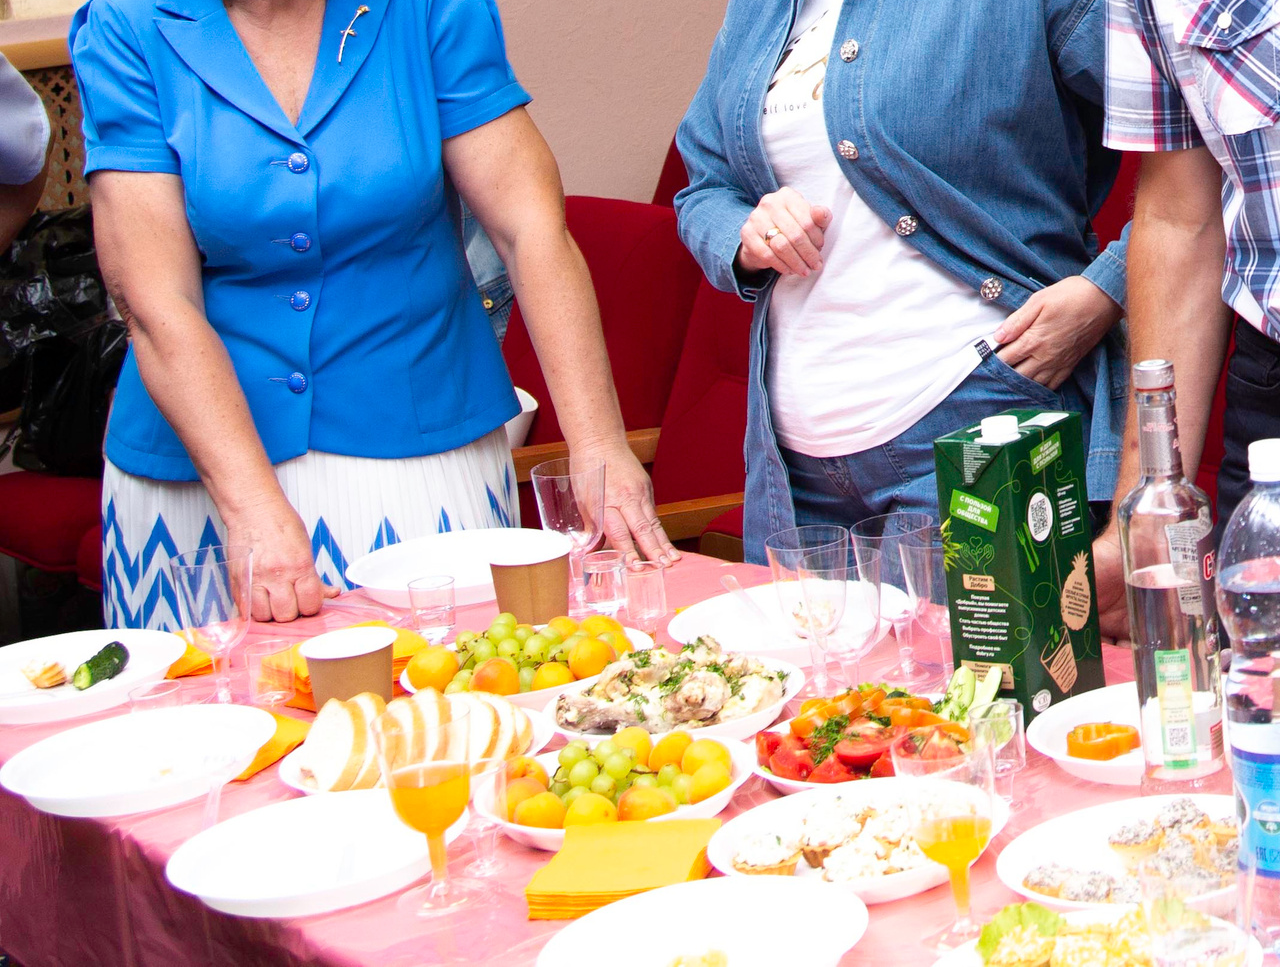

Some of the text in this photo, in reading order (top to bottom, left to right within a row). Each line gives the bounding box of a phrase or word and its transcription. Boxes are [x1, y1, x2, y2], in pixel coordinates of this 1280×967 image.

[783, 101, 807, 112] love
[965, 497, 992, 512] ПОЛЬЗОЙ
[968, 505, 981, 515] ДЛЯ
[957, 508, 988, 525] ОБЩЕСТВА
